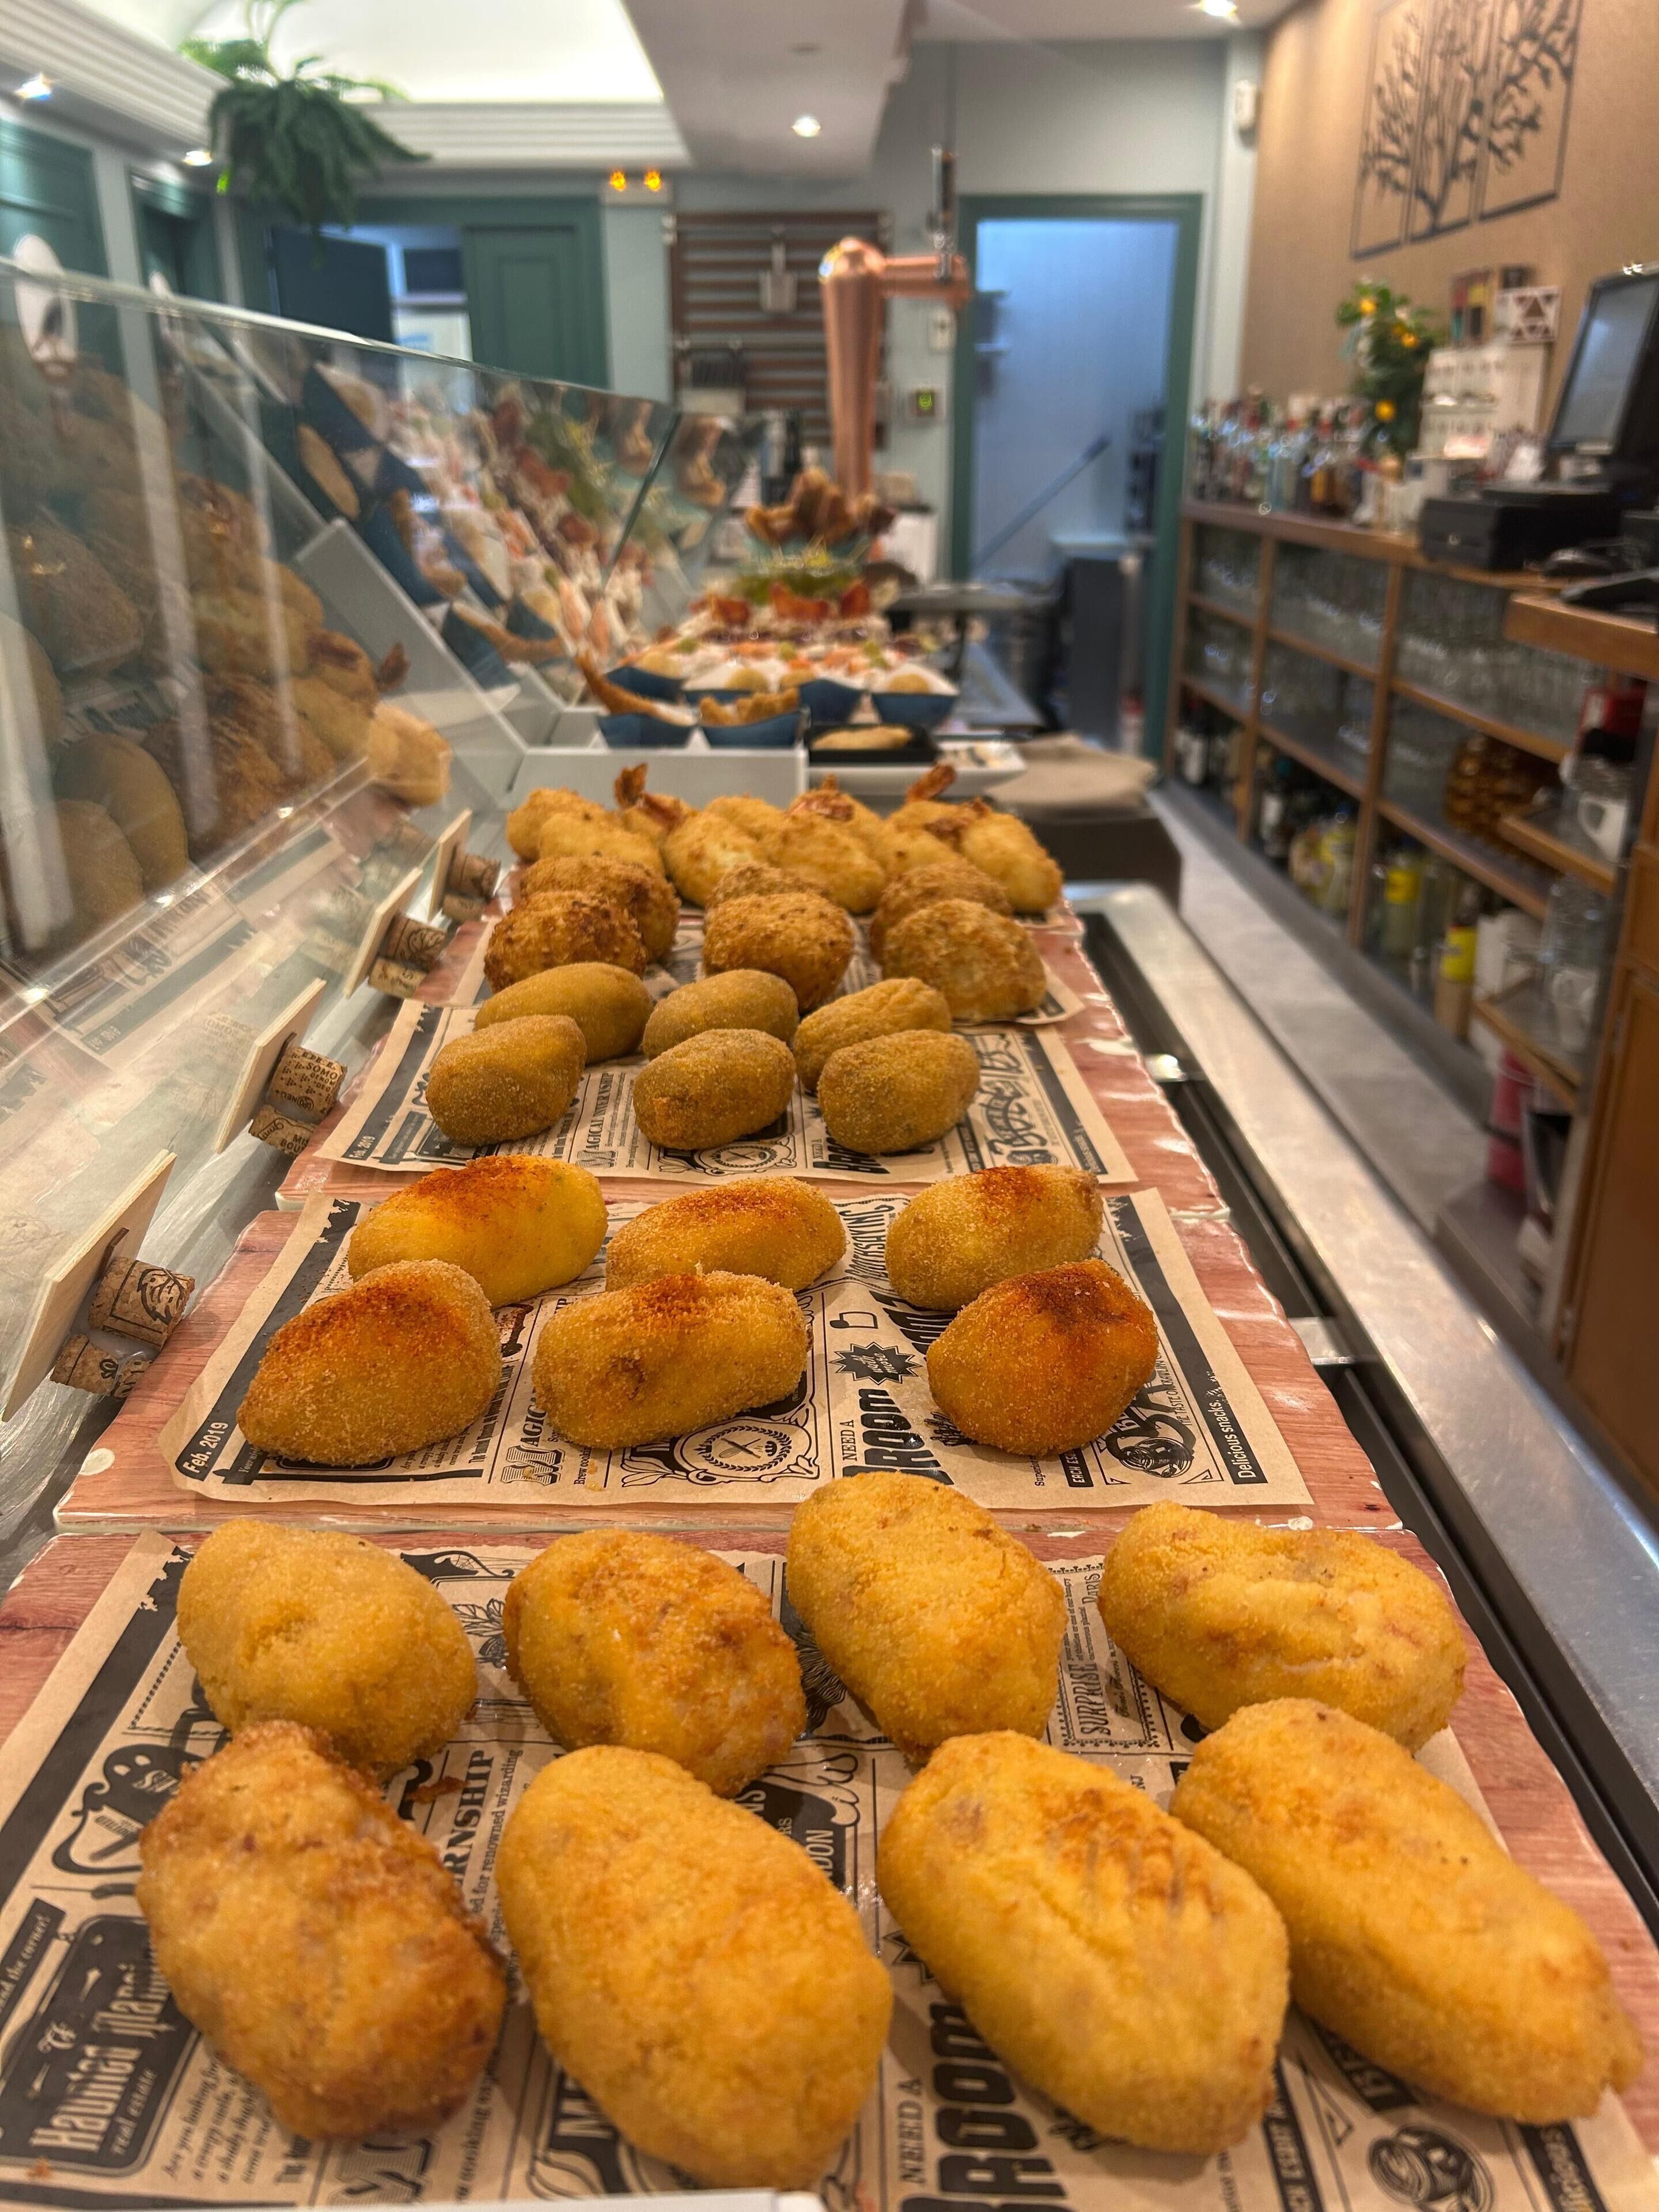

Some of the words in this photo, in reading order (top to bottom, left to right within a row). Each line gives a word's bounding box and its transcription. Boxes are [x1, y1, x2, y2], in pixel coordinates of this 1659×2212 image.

[839, 1419, 855, 1428] A
[1207, 1399, 1234, 1433] snacks.
[183, 1451, 212, 1474] Feb.
[199, 1422, 229, 1449] 2019
[840, 1430, 858, 1461] NEED
[1224, 1434, 1256, 1479] Delicious
[574, 1464, 588, 1486] Brew
[1069, 1466, 1086, 1483] EACH
[1068, 1663, 1111, 1736] SURPRISE
[472, 1875, 490, 1894] for
[482, 1810, 506, 1872] renowned
[496, 1749, 523, 1807] wizarding
[29, 2045, 143, 2153] Haunted
[896, 2079, 922, 2095] A
[897, 2100, 926, 2184] NEED
